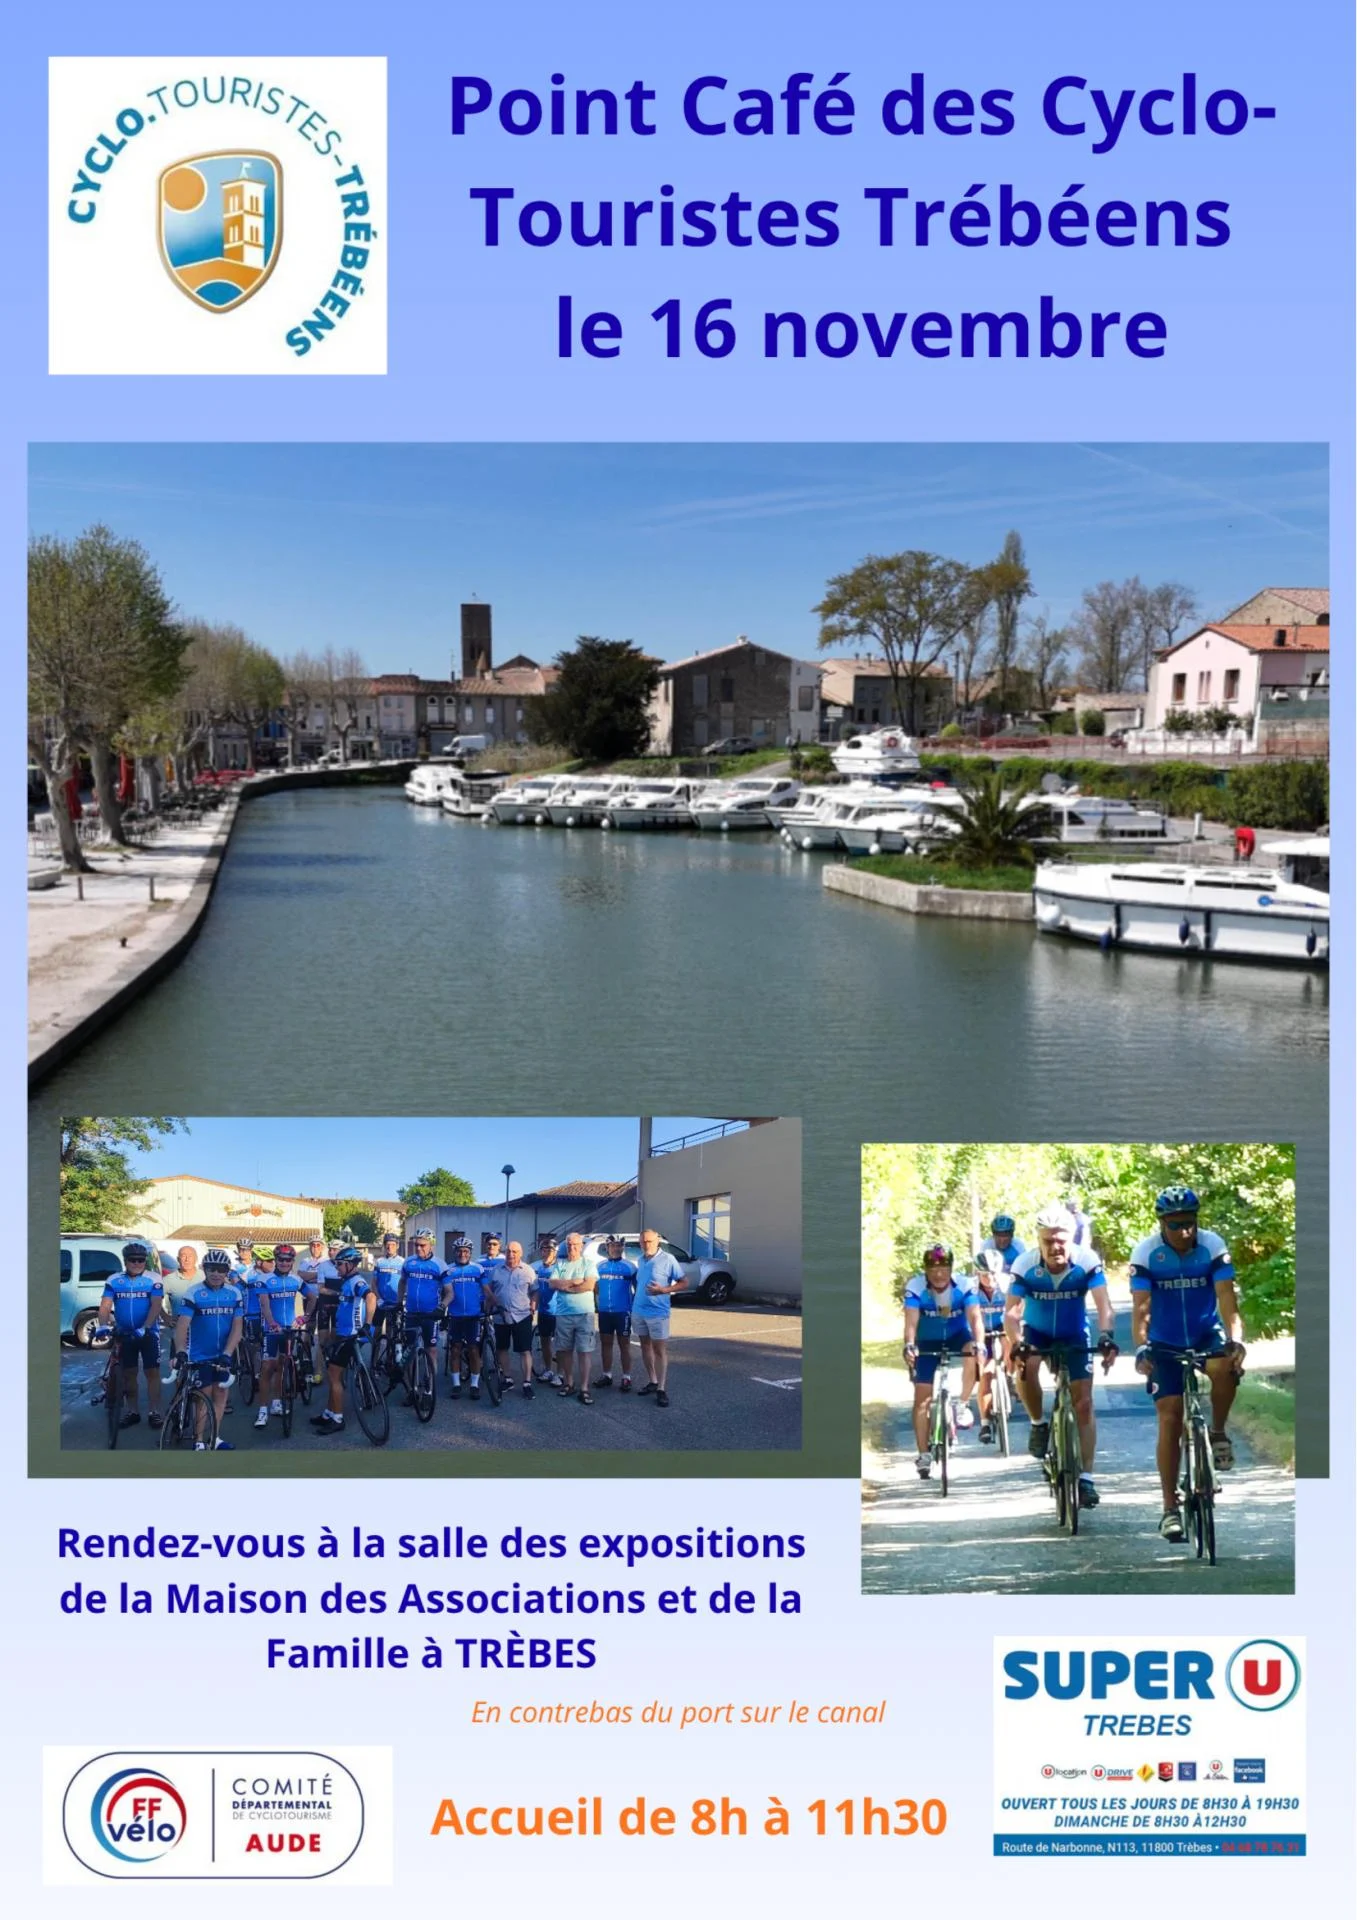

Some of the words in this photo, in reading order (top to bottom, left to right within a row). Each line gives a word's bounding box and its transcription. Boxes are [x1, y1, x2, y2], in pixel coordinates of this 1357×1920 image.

[452, 73, 656, 135] Point
[684, 73, 855, 135] Café
[882, 73, 1014, 135] des
[1043, 73, 1275, 154] Cyclo-
[470, 184, 839, 247] Touristes
[864, 184, 1230, 247] Trébéens
[559, 296, 622, 358] le
[651, 298, 736, 358] 16
[765, 296, 1166, 358] novembre
[1032, 1290, 1079, 1300] TREBES
[1157, 1277, 1207, 1290] TREBES
[59, 1526, 305, 1558] Rendez-vous
[318, 1526, 338, 1558] à
[354, 1526, 384, 1558] la
[399, 1526, 487, 1558] salle
[501, 1526, 566, 1558] des
[580, 1527, 805, 1567] expositions
[60, 1582, 106, 1614] de
[121, 1582, 152, 1614] la
[168, 1582, 306, 1614] Maison
[321, 1582, 387, 1614] des
[398, 1582, 645, 1614] Associations
[658, 1586, 697, 1614] et
[709, 1582, 755, 1614] de
[769, 1582, 800, 1614] la
[268, 1637, 408, 1668] Famille
[422, 1637, 442, 1668] à
[455, 1630, 596, 1668] TRÈBES
[1003, 1650, 1215, 1700] SUPER
[1243, 1659, 1281, 1696] U
[472, 1701, 501, 1723] En
[510, 1700, 632, 1723] contrebas
[641, 1700, 672, 1723] du
[680, 1701, 735, 1729] port
[740, 1706, 782, 1723] sur
[789, 1700, 809, 1723] le
[818, 1700, 886, 1723] canal
[1084, 1714, 1192, 1736] TREBES
[232, 1773, 333, 1796] COMITÉ
[133, 1798, 162, 1819] FF
[232, 1799, 332, 1810] DÉPARTEMENTAL
[1001, 1798, 1056, 1811] OUVERT
[1061, 1798, 1098, 1811] TOUS
[1101, 1798, 1127, 1811] LES
[1130, 1798, 1177, 1811] JOURS
[1181, 1798, 1199, 1811] DE
[1202, 1798, 1238, 1811] 8H30
[1241, 1794, 1251, 1811] À
[1257, 1798, 1299, 1811] 19H30
[232, 1811, 244, 1820] DE
[249, 1811, 332, 1820] CYCLOTOURISME
[431, 1797, 602, 1836] Accueil
[619, 1797, 676, 1836] de
[691, 1797, 747, 1836] 8h
[764, 1797, 789, 1836] à
[808, 1797, 947, 1836] 11h30
[1054, 1815, 1128, 1828] DIMANCHE
[1133, 1815, 1151, 1828] DE
[1154, 1815, 1190, 1828] 8H30
[107, 1816, 176, 1842] vélo
[245, 1833, 321, 1853] AUDE
[1002, 1842, 1033, 1853] Route
[1036, 1842, 1048, 1853] de
[1052, 1842, 1104, 1855] Narbonne,
[1108, 1842, 1138, 1855] N113,
[1142, 1842, 1173, 1853] 11800
[1177, 1842, 1212, 1853] Trèbes
